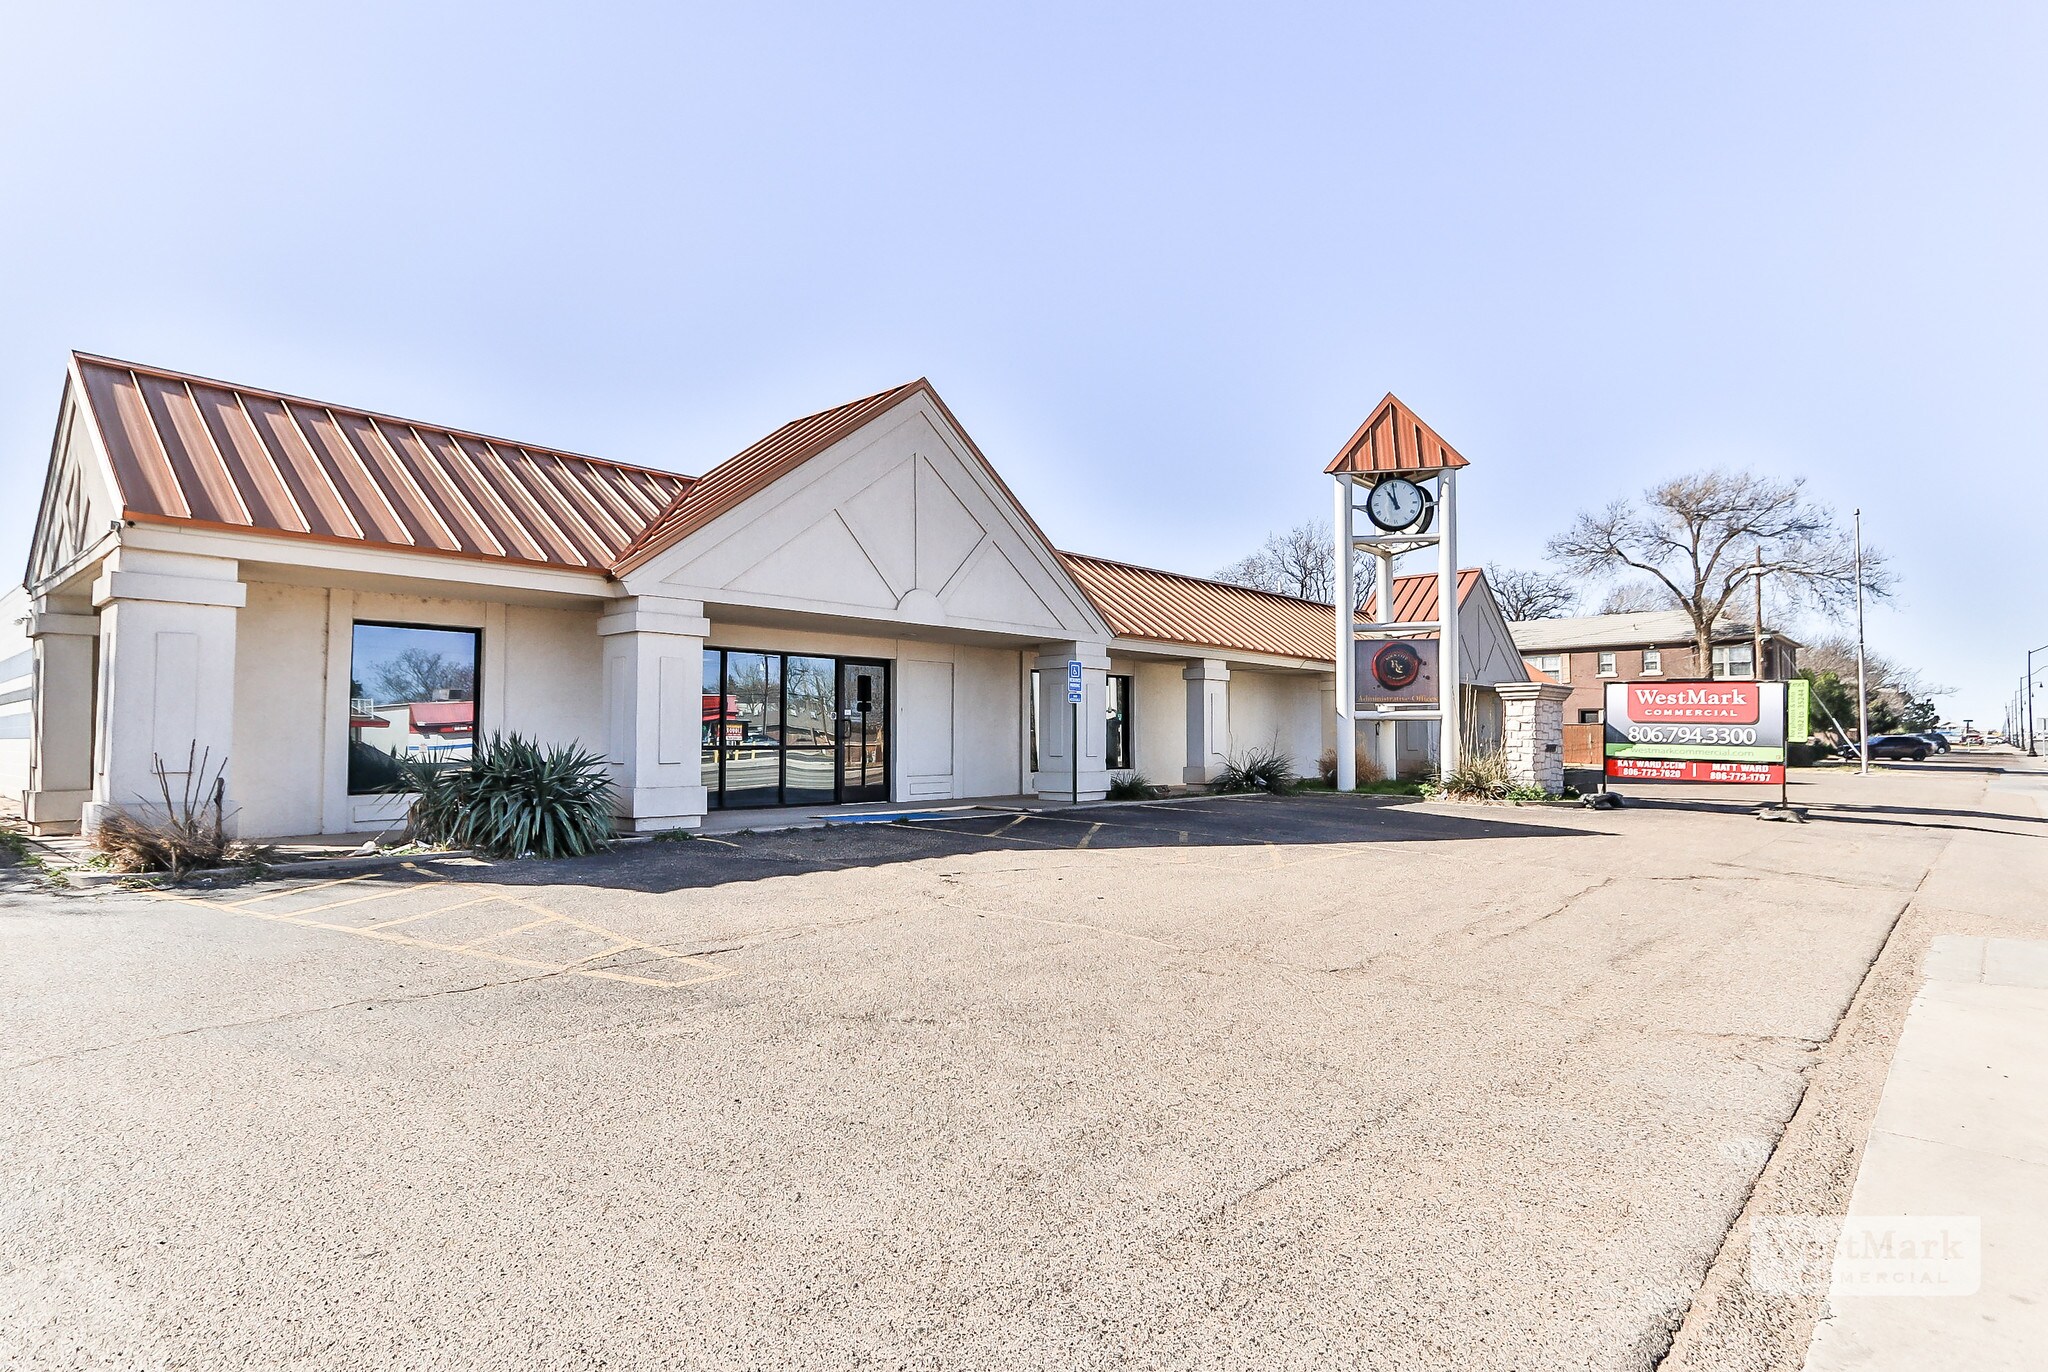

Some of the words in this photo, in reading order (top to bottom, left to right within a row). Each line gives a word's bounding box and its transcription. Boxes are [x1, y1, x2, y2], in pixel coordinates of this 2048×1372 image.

[1634, 688, 1747, 705] WestMark
[1644, 709, 1738, 717] COMMERCIAL
[1627, 725, 1757, 745] 806.794.3300
[1712, 763, 1738, 771] MATT
[1740, 765, 1769, 773] WARD
